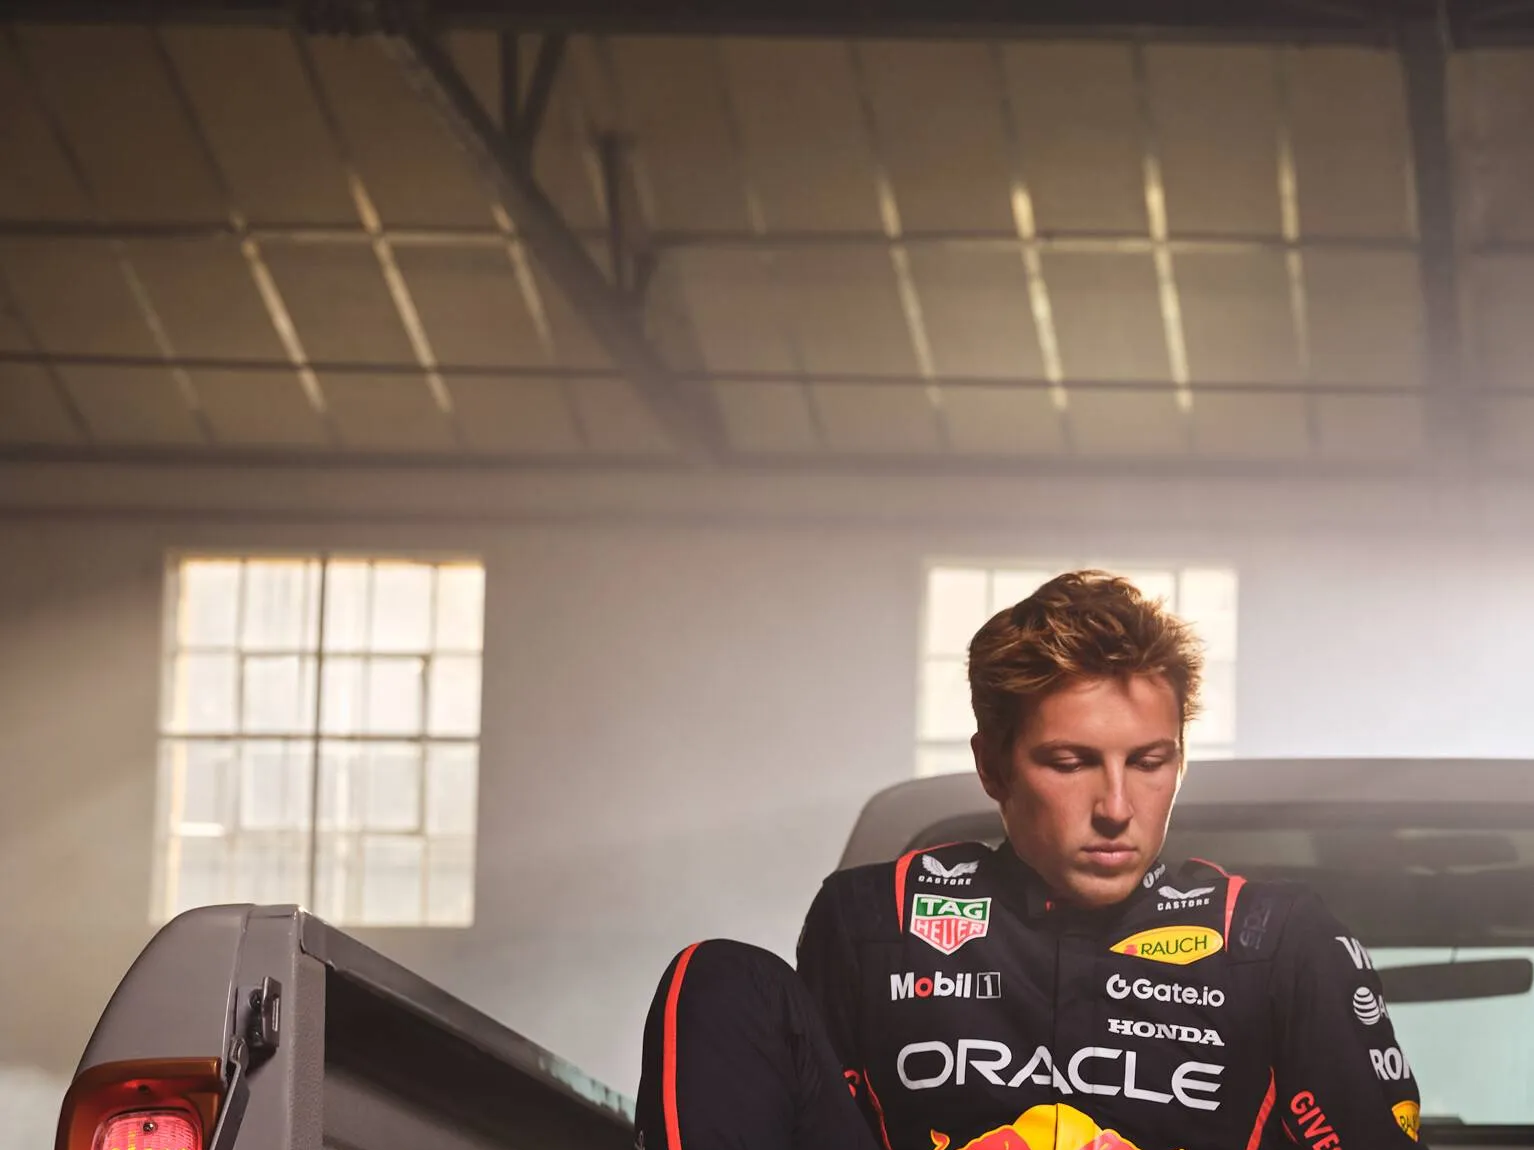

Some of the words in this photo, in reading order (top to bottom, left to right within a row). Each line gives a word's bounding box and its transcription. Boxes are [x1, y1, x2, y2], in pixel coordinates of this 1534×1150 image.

[917, 875, 973, 886] CASTORE
[920, 898, 985, 920] TAG
[1157, 898, 1210, 911] CASTORE
[915, 918, 985, 950] HEUER
[1140, 935, 1208, 956] RAUCH
[890, 971, 973, 1001] Mobil
[1132, 978, 1225, 1007] Gate.io
[1108, 1018, 1225, 1046] HONDA
[896, 1038, 1225, 1111] ORACLE
